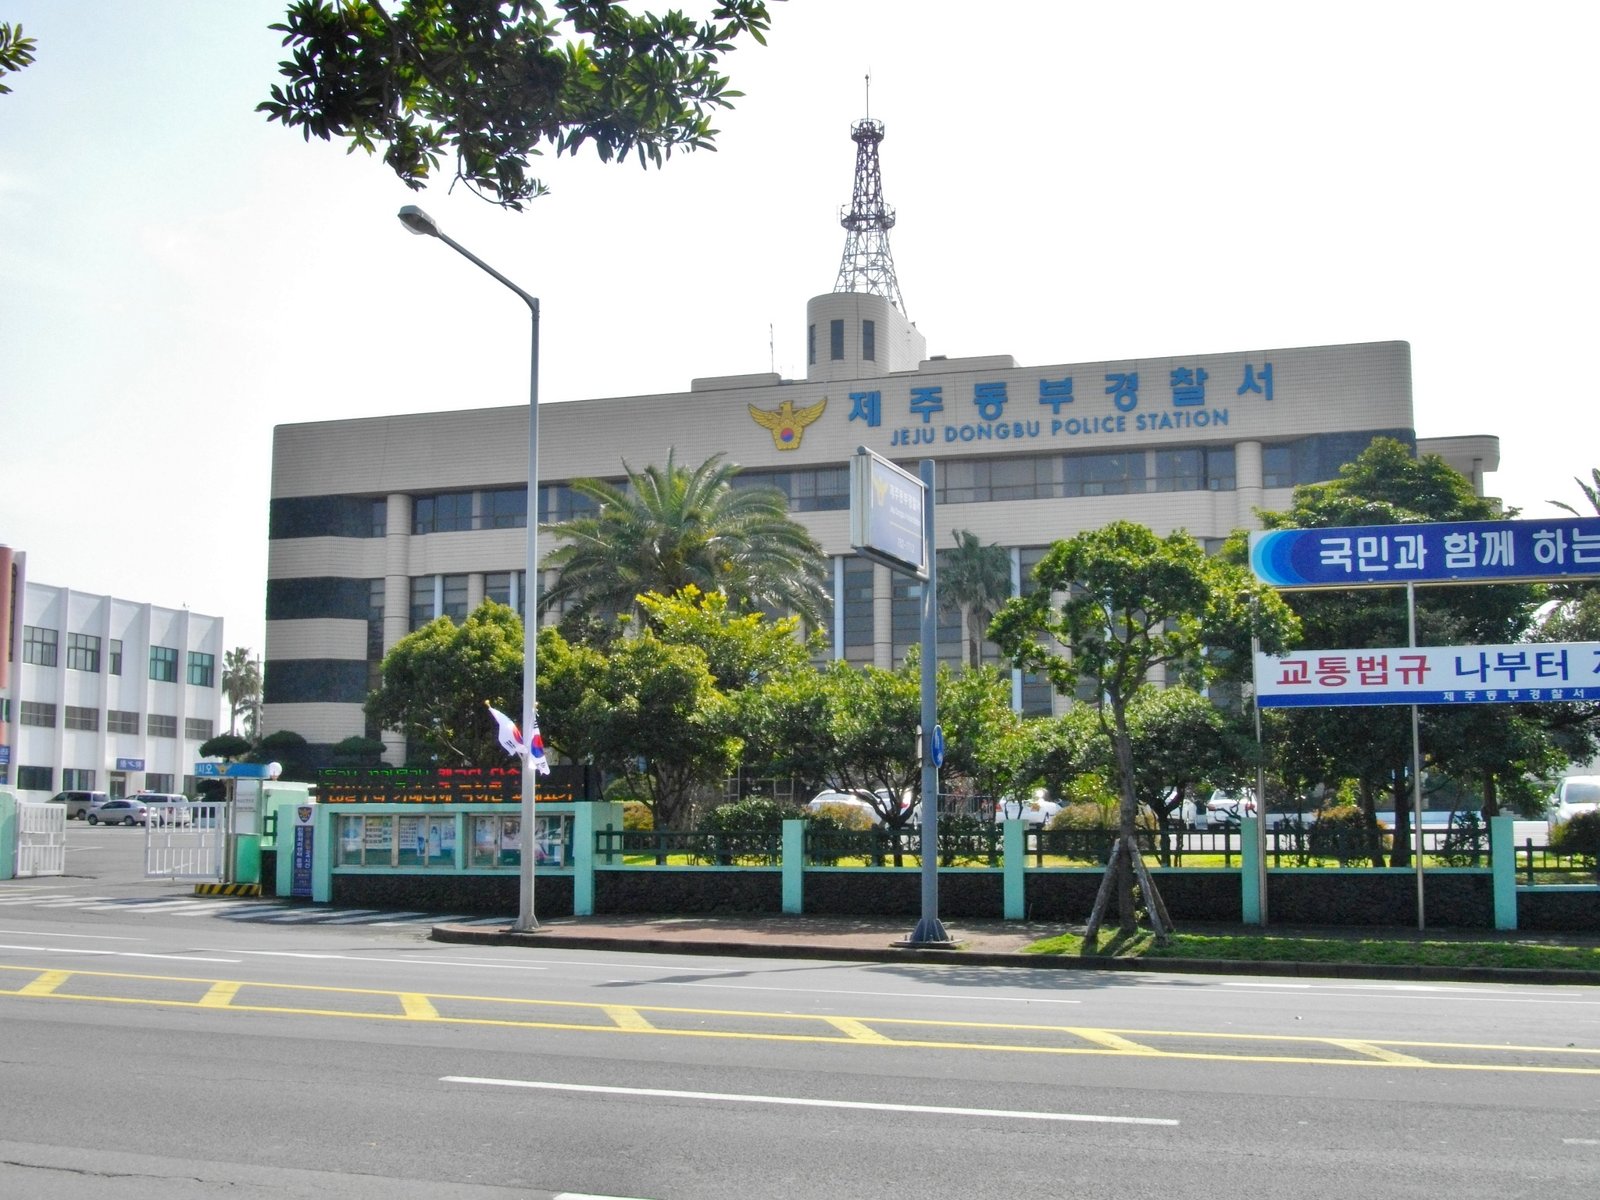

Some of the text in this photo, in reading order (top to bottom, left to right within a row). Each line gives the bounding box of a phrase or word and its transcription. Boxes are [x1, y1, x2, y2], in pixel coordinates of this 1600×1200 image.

[848, 362, 1273, 427] 제주동부경찰서
[890, 408, 1229, 446] JEJU DONGBU POLICE STATION
[1319, 528, 1600, 573] 국민과 함께 하는
[1276, 654, 1431, 687] 교통법규
[1455, 649, 1569, 683] 나부터
[1443, 688, 1585, 702] 제주동부경찰서
